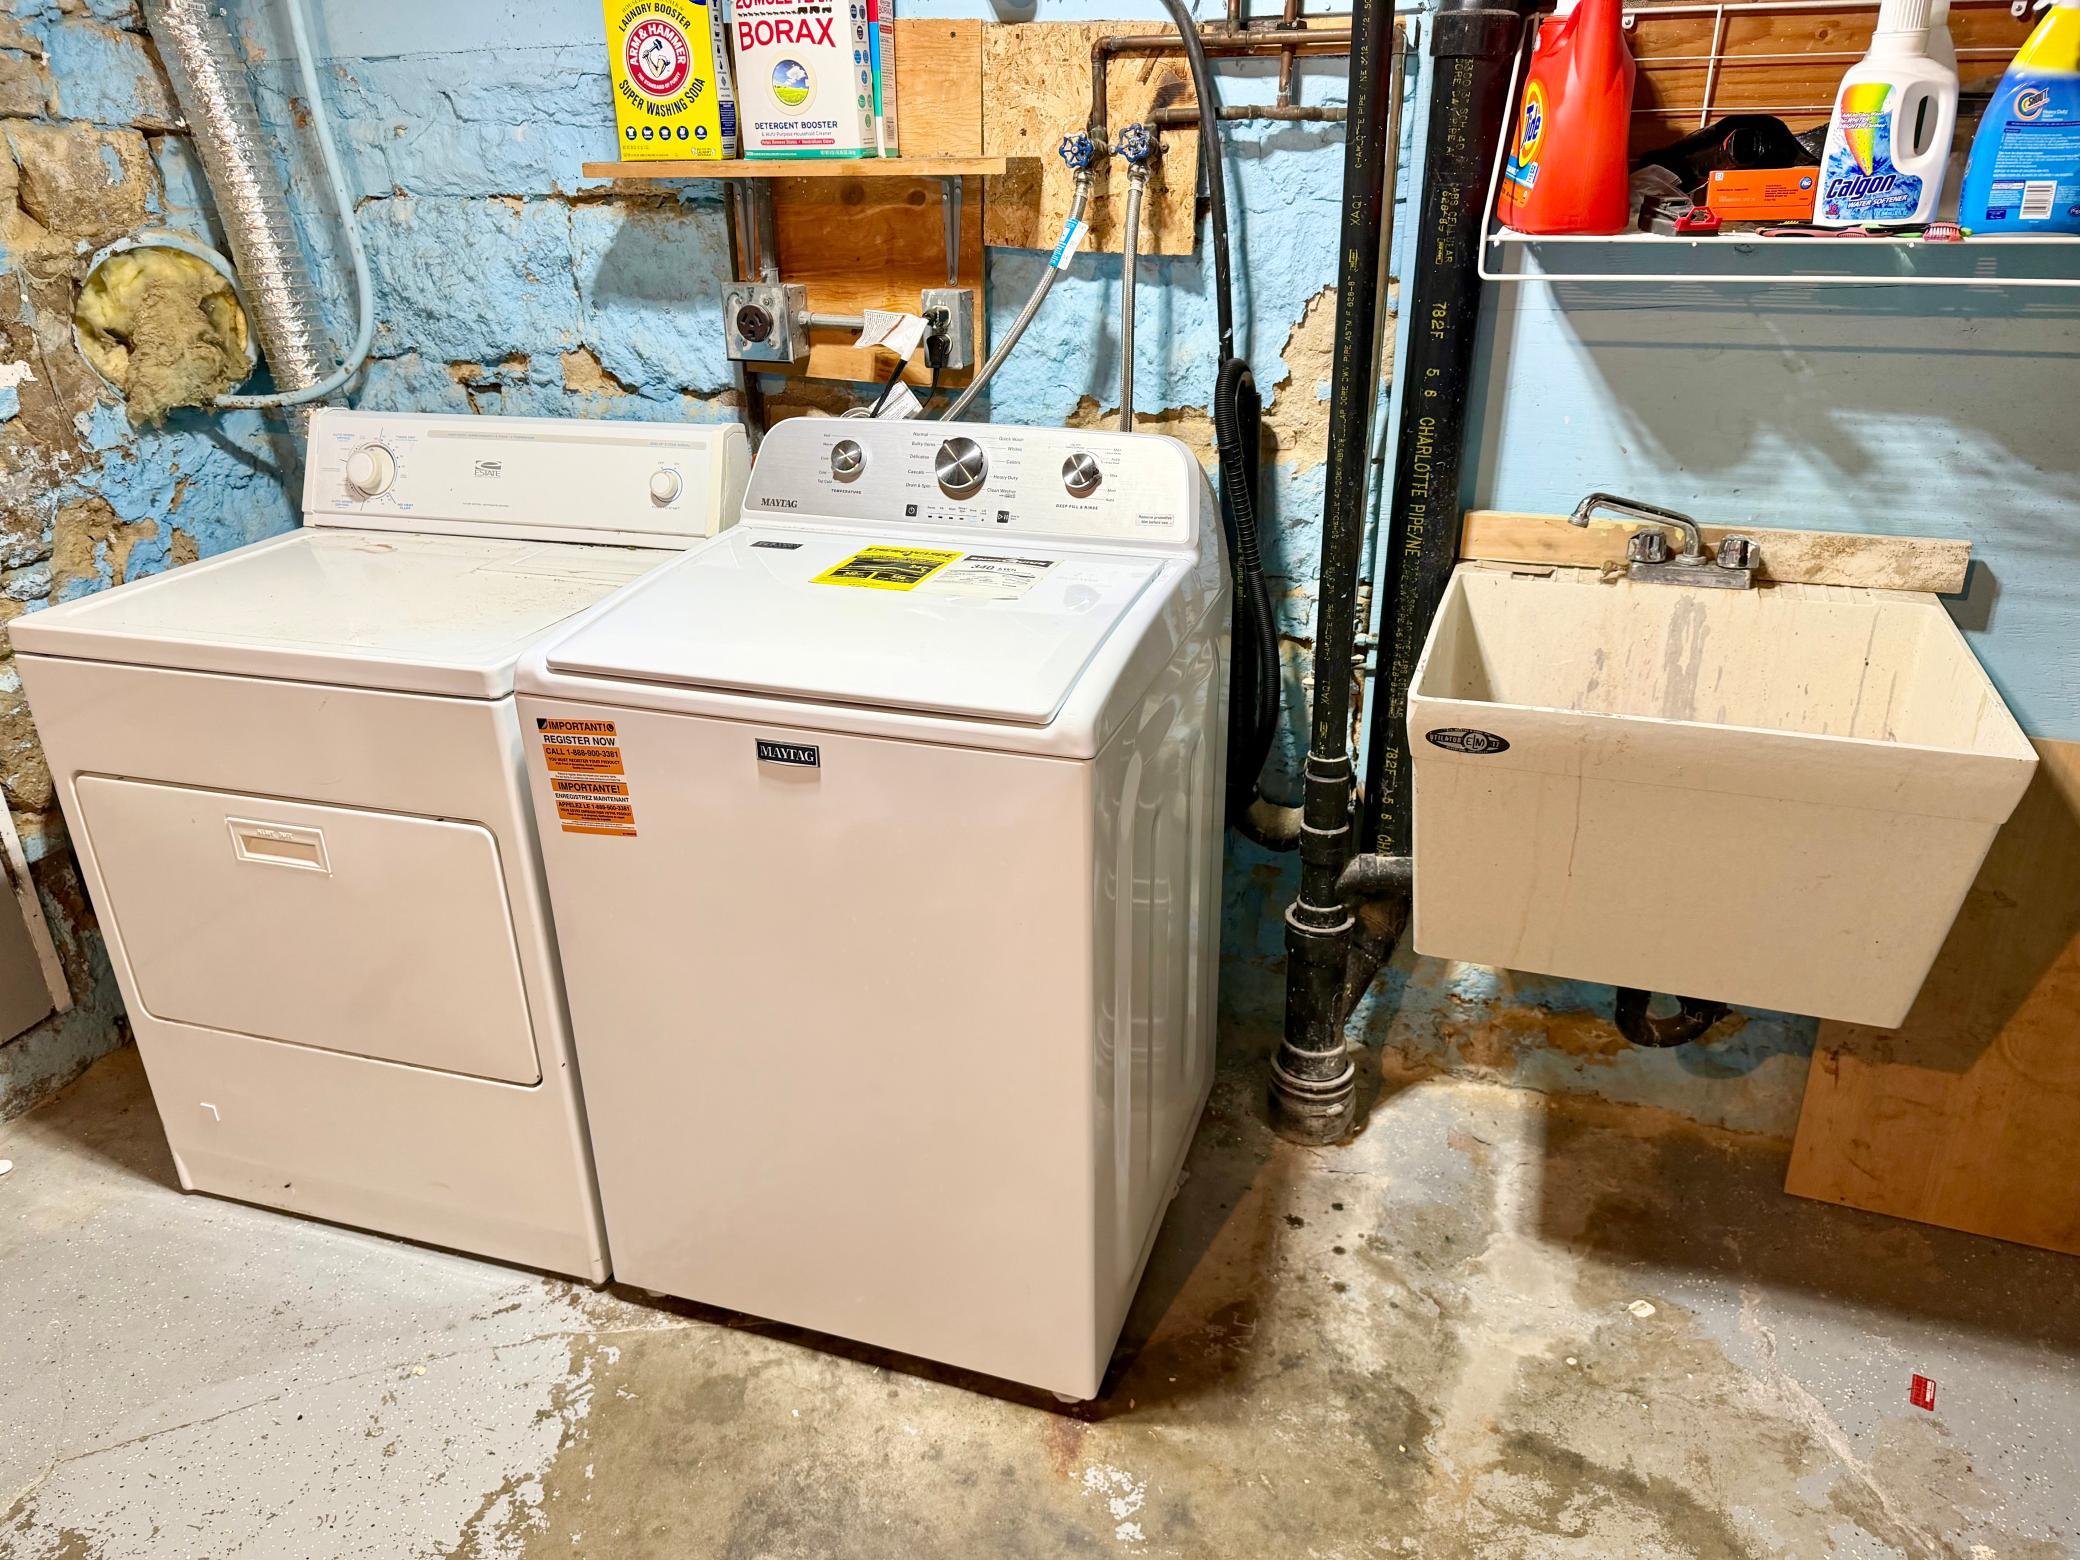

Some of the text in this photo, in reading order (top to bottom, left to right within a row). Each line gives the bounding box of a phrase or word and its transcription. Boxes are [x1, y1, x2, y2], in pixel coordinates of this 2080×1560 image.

[619, 3, 691, 32] LAUNDRY BOOSTER
[738, 17, 836, 51] BORAX
[629, 24, 687, 65] ARM & HAMMER
[619, 77, 706, 118] SUPER WASHING SODA
[754, 120, 838, 130] DETERGENT BOOSTER
[1521, 103, 1541, 148] Tide
[1826, 174, 1897, 200] Calgon
[1350, 194, 1362, 226] XAQ1
[1847, 195, 1908, 208] WATER SOFTENER
[1430, 302, 1447, 340] 782F
[1411, 417, 1435, 498] CHARLOTTE
[474, 469, 501, 477] ESTATE
[761, 497, 798, 509] MAYTAG
[548, 720, 606, 731] IMPORTANT!
[543, 735, 616, 746] REGISTER NOW
[545, 747, 565, 755] CALL
[760, 745, 814, 762] MAYTAG
[558, 782, 620, 793] IMPORTANTE!
[555, 793, 592, 801] ENREGISTREZ
